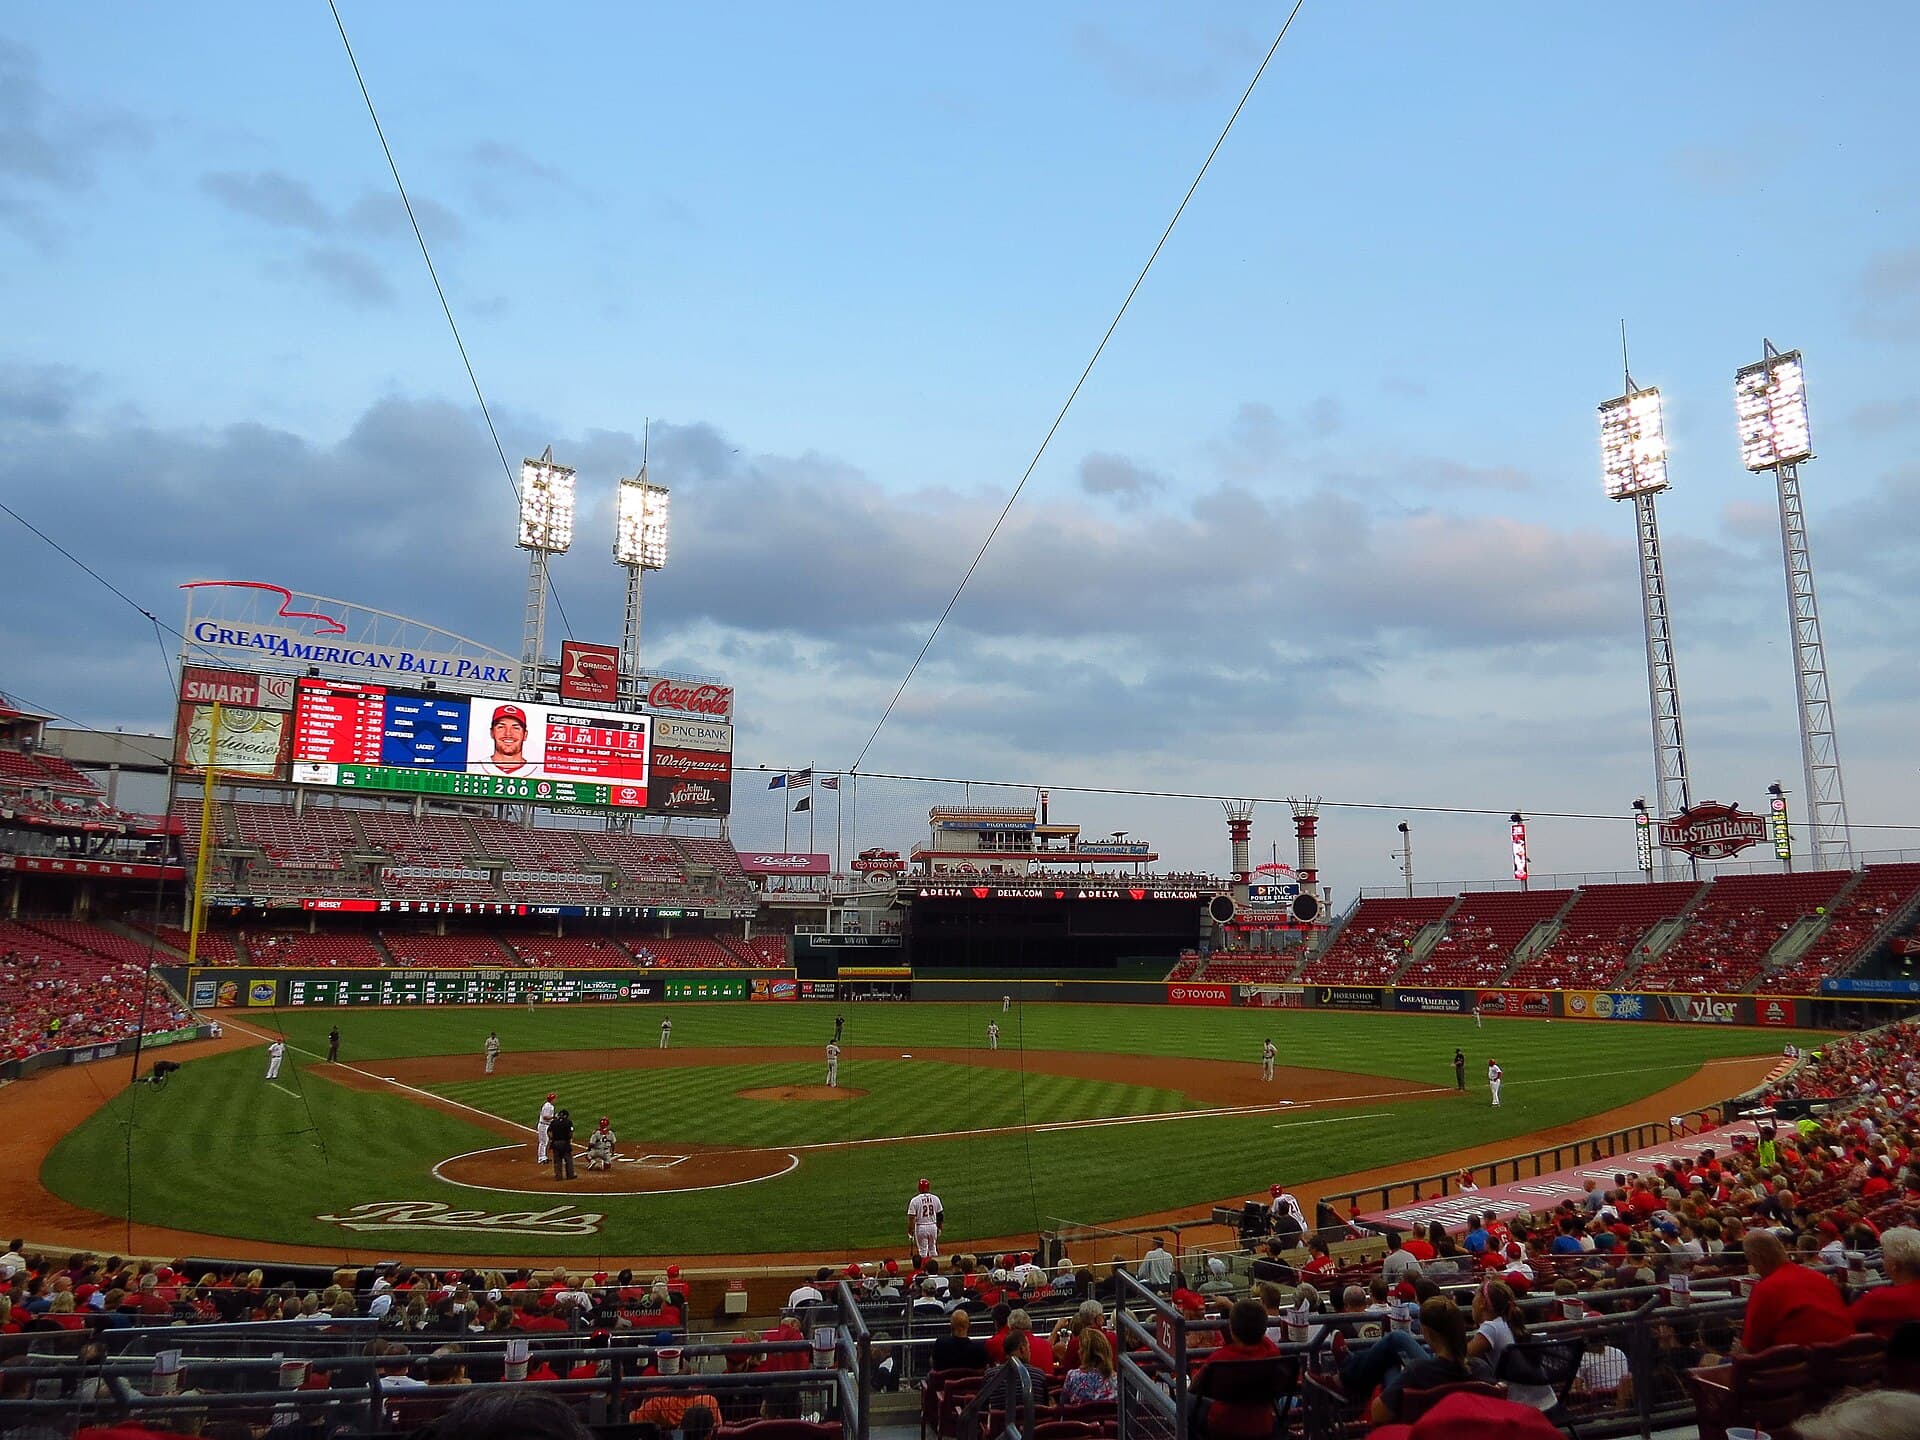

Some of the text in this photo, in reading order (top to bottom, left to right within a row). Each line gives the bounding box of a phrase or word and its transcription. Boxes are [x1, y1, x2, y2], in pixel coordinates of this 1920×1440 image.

[194, 622, 513, 683] GREAT AMERICAN BALL PARK
[578, 662, 613, 671] FORMICA
[187, 682, 255, 704] SMART
[550, 732, 637, 748] .230 .674 8 21
[672, 726, 727, 740] PNC BANK
[656, 754, 727, 772] Walgreens
[495, 784, 528, 796] 2 0 0
[684, 783, 703, 792] John
[665, 790, 716, 806] Morrell
[1663, 820, 1761, 842] ALL STAR GAME
[753, 855, 810, 866] Reds
[998, 889, 1042, 898] DELTA.COM
[1154, 891, 1197, 899] DELTA.COM
[1267, 886, 1290, 895] PNC
[1186, 990, 1226, 999] TOYOTA
[316, 1201, 604, 1235] Reds
[1163, 1320, 1170, 1348] 25
